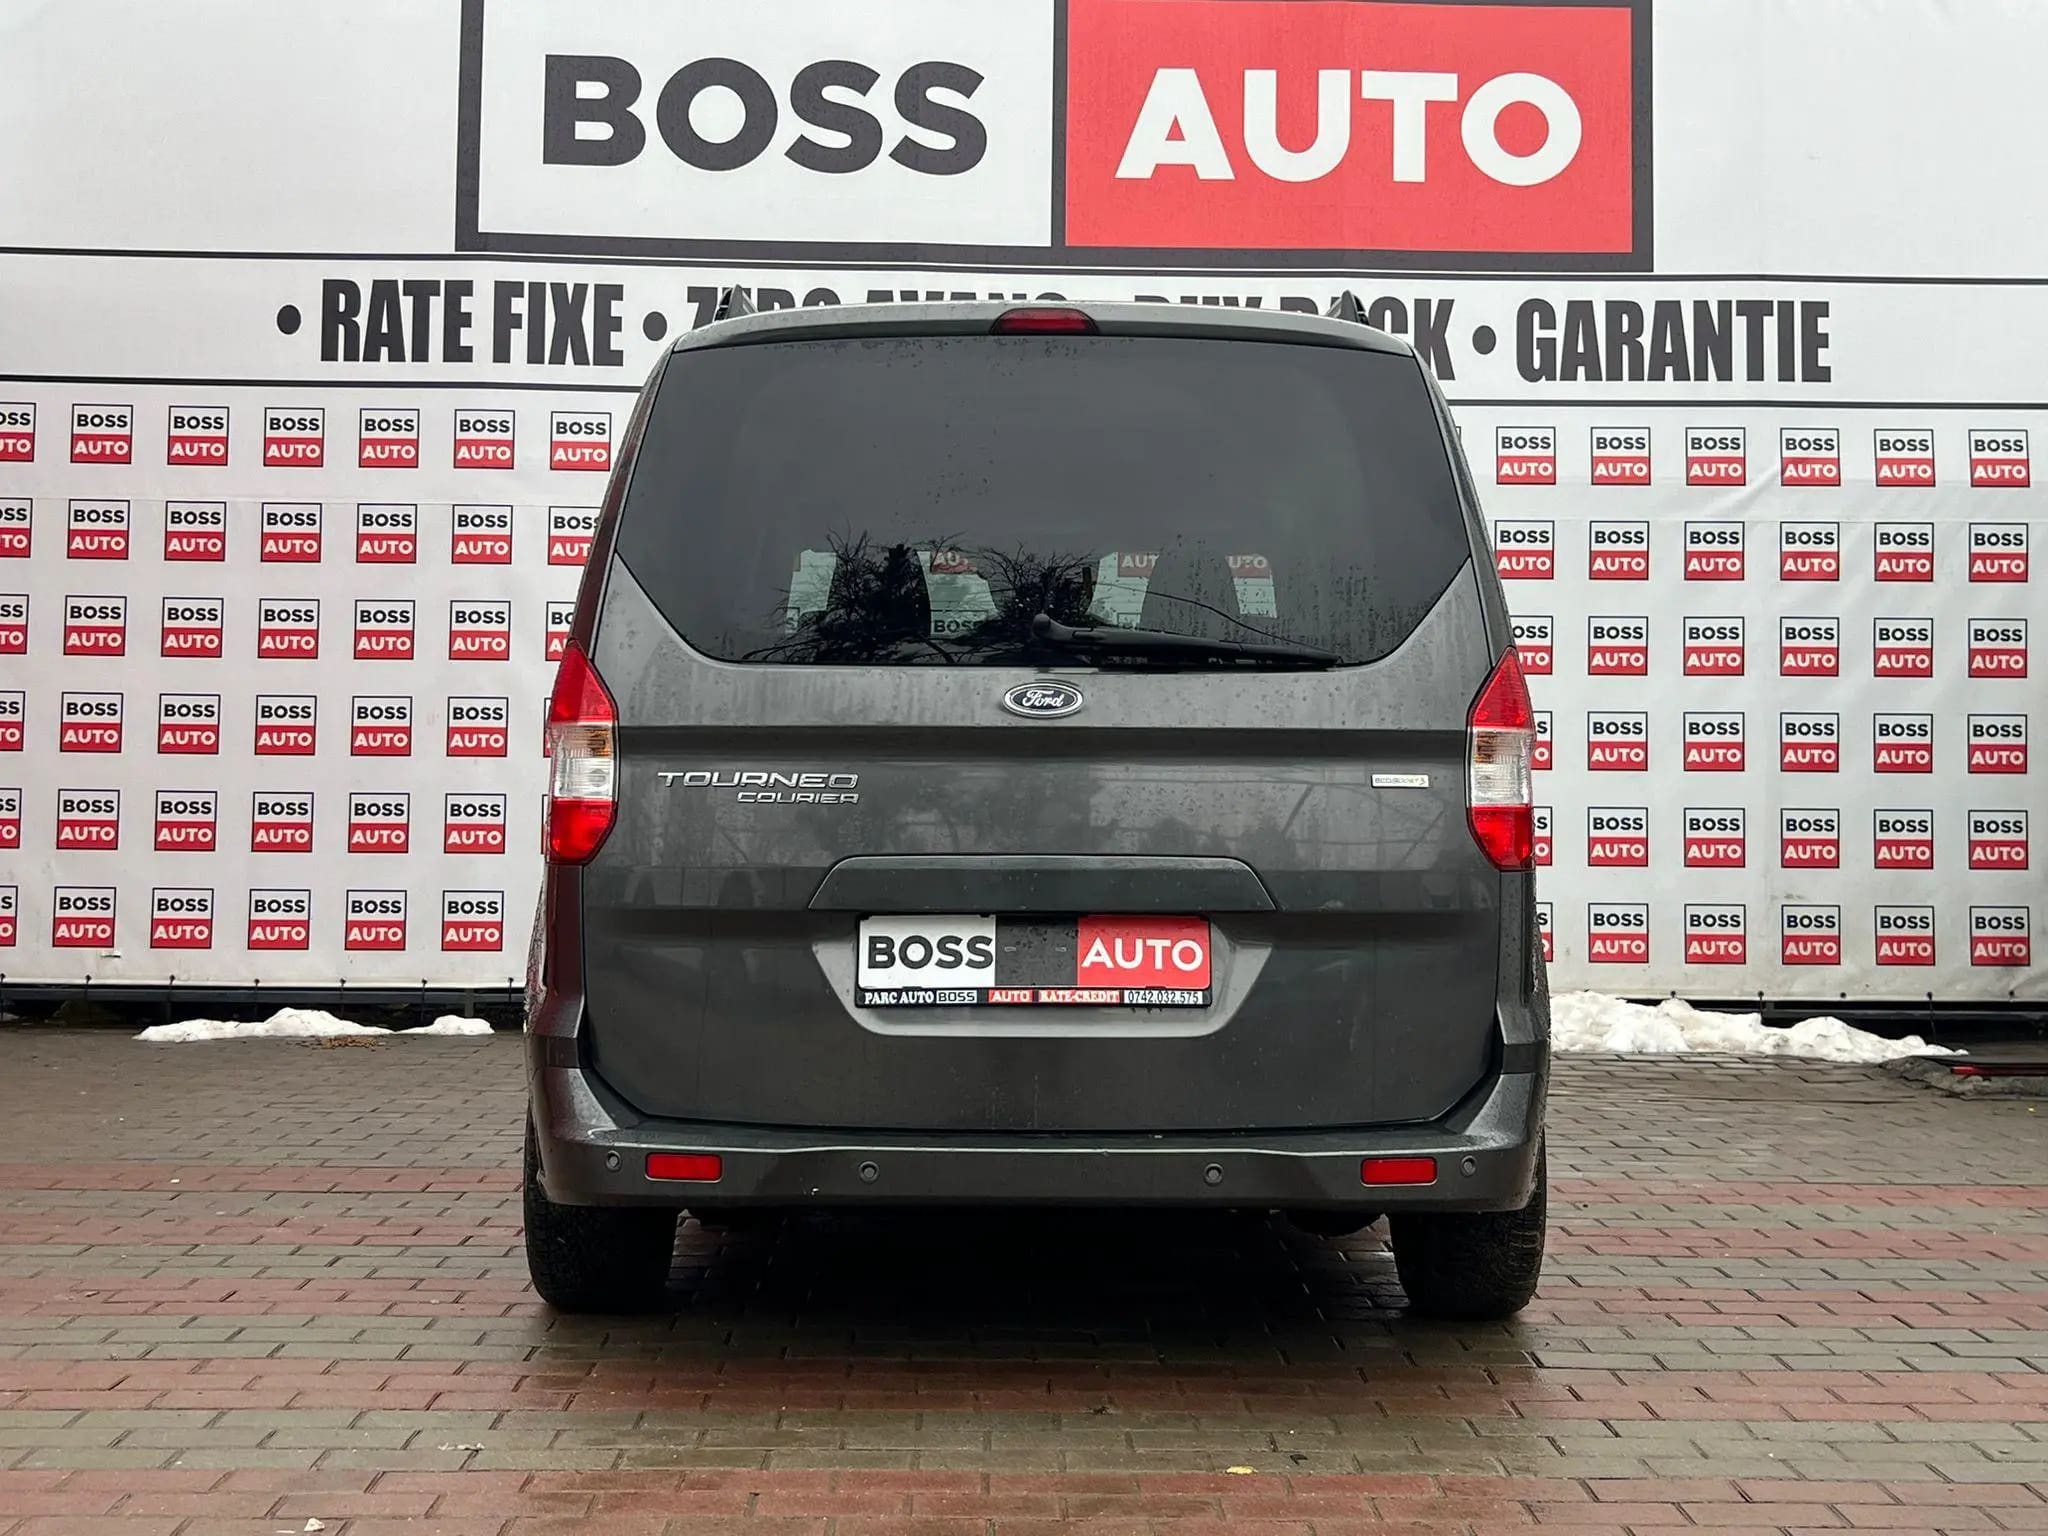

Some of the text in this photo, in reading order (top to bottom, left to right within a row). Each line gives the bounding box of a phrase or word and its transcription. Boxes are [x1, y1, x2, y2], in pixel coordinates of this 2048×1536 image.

[542, 53, 1583, 187] BOSS AUTO
[319, 278, 474, 364] RATE
[492, 279, 624, 367] FIXE
[1515, 297, 1832, 384] GARANTIE
[76, 413, 128, 429] BOSS
[173, 415, 225, 430] BOSS
[269, 417, 320, 432] BOSS
[364, 418, 415, 433] BOSS
[459, 418, 511, 434] BOSS
[555, 421, 607, 436] BOSS
[72, 440, 129, 456] AUTO
[170, 442, 225, 457] AUTO
[1501, 435, 1552, 450] BOSS
[1595, 436, 1646, 451] BOSS
[1689, 436, 1741, 451] BOSS
[1783, 437, 1835, 452] BOSS
[1879, 438, 1930, 452] BOSS
[1972, 439, 2024, 453] BOSS
[266, 443, 321, 459] AUTO
[361, 444, 416, 460] AUTO
[456, 445, 512, 461] AUTO
[553, 447, 608, 463] AUTO
[1499, 462, 1553, 477] AUTO
[1593, 462, 1648, 477] AUTO
[1688, 462, 1744, 478] AUTO
[1783, 463, 1838, 478] AUTO
[1878, 464, 1933, 479] AUTO
[1973, 464, 2027, 479] AUTO
[73, 508, 125, 524] BOSS
[170, 510, 222, 526] BOSS
[266, 512, 317, 527] BOSS
[361, 513, 413, 528] BOSS
[457, 513, 508, 529] BOSS
[69, 535, 126, 551] AUTO
[1499, 529, 1550, 544] BOSS
[1594, 530, 1645, 545] BOSS
[1689, 530, 1740, 545] BOSS
[1784, 531, 1835, 546] BOSS
[1879, 532, 1930, 546] BOSS
[1973, 532, 2024, 547] BOSS
[167, 537, 223, 553] AUTO
[263, 539, 318, 554] AUTO
[358, 540, 414, 555] AUTO
[454, 540, 509, 556] AUTO
[551, 542, 591, 557] AUT
[1121, 553, 1160, 569] AUT
[1228, 555, 1268, 569] UTO
[1496, 556, 1552, 571] AUTO
[1591, 556, 1647, 572] AUTO
[1687, 557, 1742, 572] AUTO
[1783, 557, 1837, 572] AUTO
[1877, 558, 1931, 573] AUTO
[1971, 559, 2026, 574] AUTO
[69, 605, 122, 620] BOSS
[167, 607, 219, 622] BOSS
[263, 608, 315, 623] BOSS
[359, 609, 411, 624] BOSS
[454, 610, 506, 625] BOSS
[1512, 625, 1549, 639] OSS
[1593, 625, 1644, 640] BOSS
[1688, 626, 1740, 641] BOSS
[1784, 626, 1835, 641] BOSS
[1878, 627, 1929, 642] BOSS
[1973, 628, 2023, 643] BOSS
[66, 632, 123, 648] AUTO
[163, 633, 220, 649] AUTO
[260, 635, 316, 650] AUTO
[356, 636, 411, 651] AUTO
[451, 636, 507, 652] AUTO
[1590, 652, 1646, 667] AUTO
[1686, 652, 1742, 667] AUTO
[1782, 653, 1837, 668] AUTO
[1876, 654, 1930, 669] AUTO
[1971, 654, 2025, 670] AUTO
[1022, 689, 1065, 707] Ford
[66, 701, 119, 717] BOSS
[163, 703, 216, 718] BOSS
[260, 704, 312, 720] BOSS
[356, 705, 408, 720] BOSS
[452, 706, 504, 721] BOSS
[1592, 721, 1644, 736] BOSS
[1688, 721, 1741, 736] BOSS
[1785, 722, 1835, 737] BOSS
[1878, 723, 1929, 738] BOSS
[1972, 723, 2023, 738] BOSS
[62, 729, 119, 744] AUTO
[160, 730, 217, 746] AUTO
[257, 731, 313, 747] AUTO
[353, 732, 409, 748] AUTO
[449, 733, 505, 748] AUTO
[1590, 747, 1645, 763] AUTO
[1686, 748, 1742, 763] AUTO
[1783, 748, 1837, 764] AUTO
[1876, 749, 1931, 765] AUTO
[1970, 750, 2025, 765] AUTO
[657, 771, 859, 789] TOURNEO
[737, 791, 859, 804] COURIER
[62, 799, 115, 814] BOSS
[160, 800, 212, 815] BOSS
[257, 801, 309, 816] BOSS
[353, 802, 405, 817] BOSS
[449, 803, 502, 818] BOSS
[1592, 816, 1644, 831] BOSS
[1688, 817, 1741, 832] BOSS
[1785, 818, 1836, 833] BOSS
[1878, 819, 1929, 834] BOSS
[1973, 819, 2024, 834] BOSS
[59, 826, 116, 841] AUTO
[156, 827, 213, 843] AUTO
[254, 828, 310, 844] AUTO
[350, 829, 406, 844] AUTO
[446, 830, 503, 845] AUTO
[1590, 843, 1645, 858] AUTO
[1686, 844, 1742, 859] AUTO
[1783, 844, 1837, 860] AUTO
[1877, 845, 1931, 861] AUTO
[1971, 846, 2026, 861] AUTO
[58, 896, 112, 911] BOSS
[156, 897, 209, 913] BOSS
[254, 899, 306, 914] BOSS
[350, 899, 402, 914] BOSS
[447, 900, 499, 915] BOSS
[1593, 912, 1645, 927] BOSS
[1689, 913, 1741, 928] BOSS
[1786, 914, 1836, 929] BOSS
[1879, 915, 1930, 930] BOSS
[1974, 916, 2026, 931] BOSS
[55, 923, 112, 939] AUTO
[152, 924, 209, 940] AUTO
[250, 926, 307, 941] AUTO
[347, 926, 403, 942] AUTO
[444, 927, 500, 943] AUTO
[867, 935, 1203, 972] BOSS AUTO
[1591, 939, 1647, 955] AUTO
[1687, 940, 1743, 956] AUTO
[1784, 941, 1838, 957] AUTO
[1878, 942, 1933, 957] AUTO
[1973, 942, 2028, 958] AUTO
[864, 991, 898, 1004] PARC
[899, 991, 932, 1004] AUTO
[938, 991, 976, 1003] BOSS
[991, 990, 1030, 1002] AUTO
